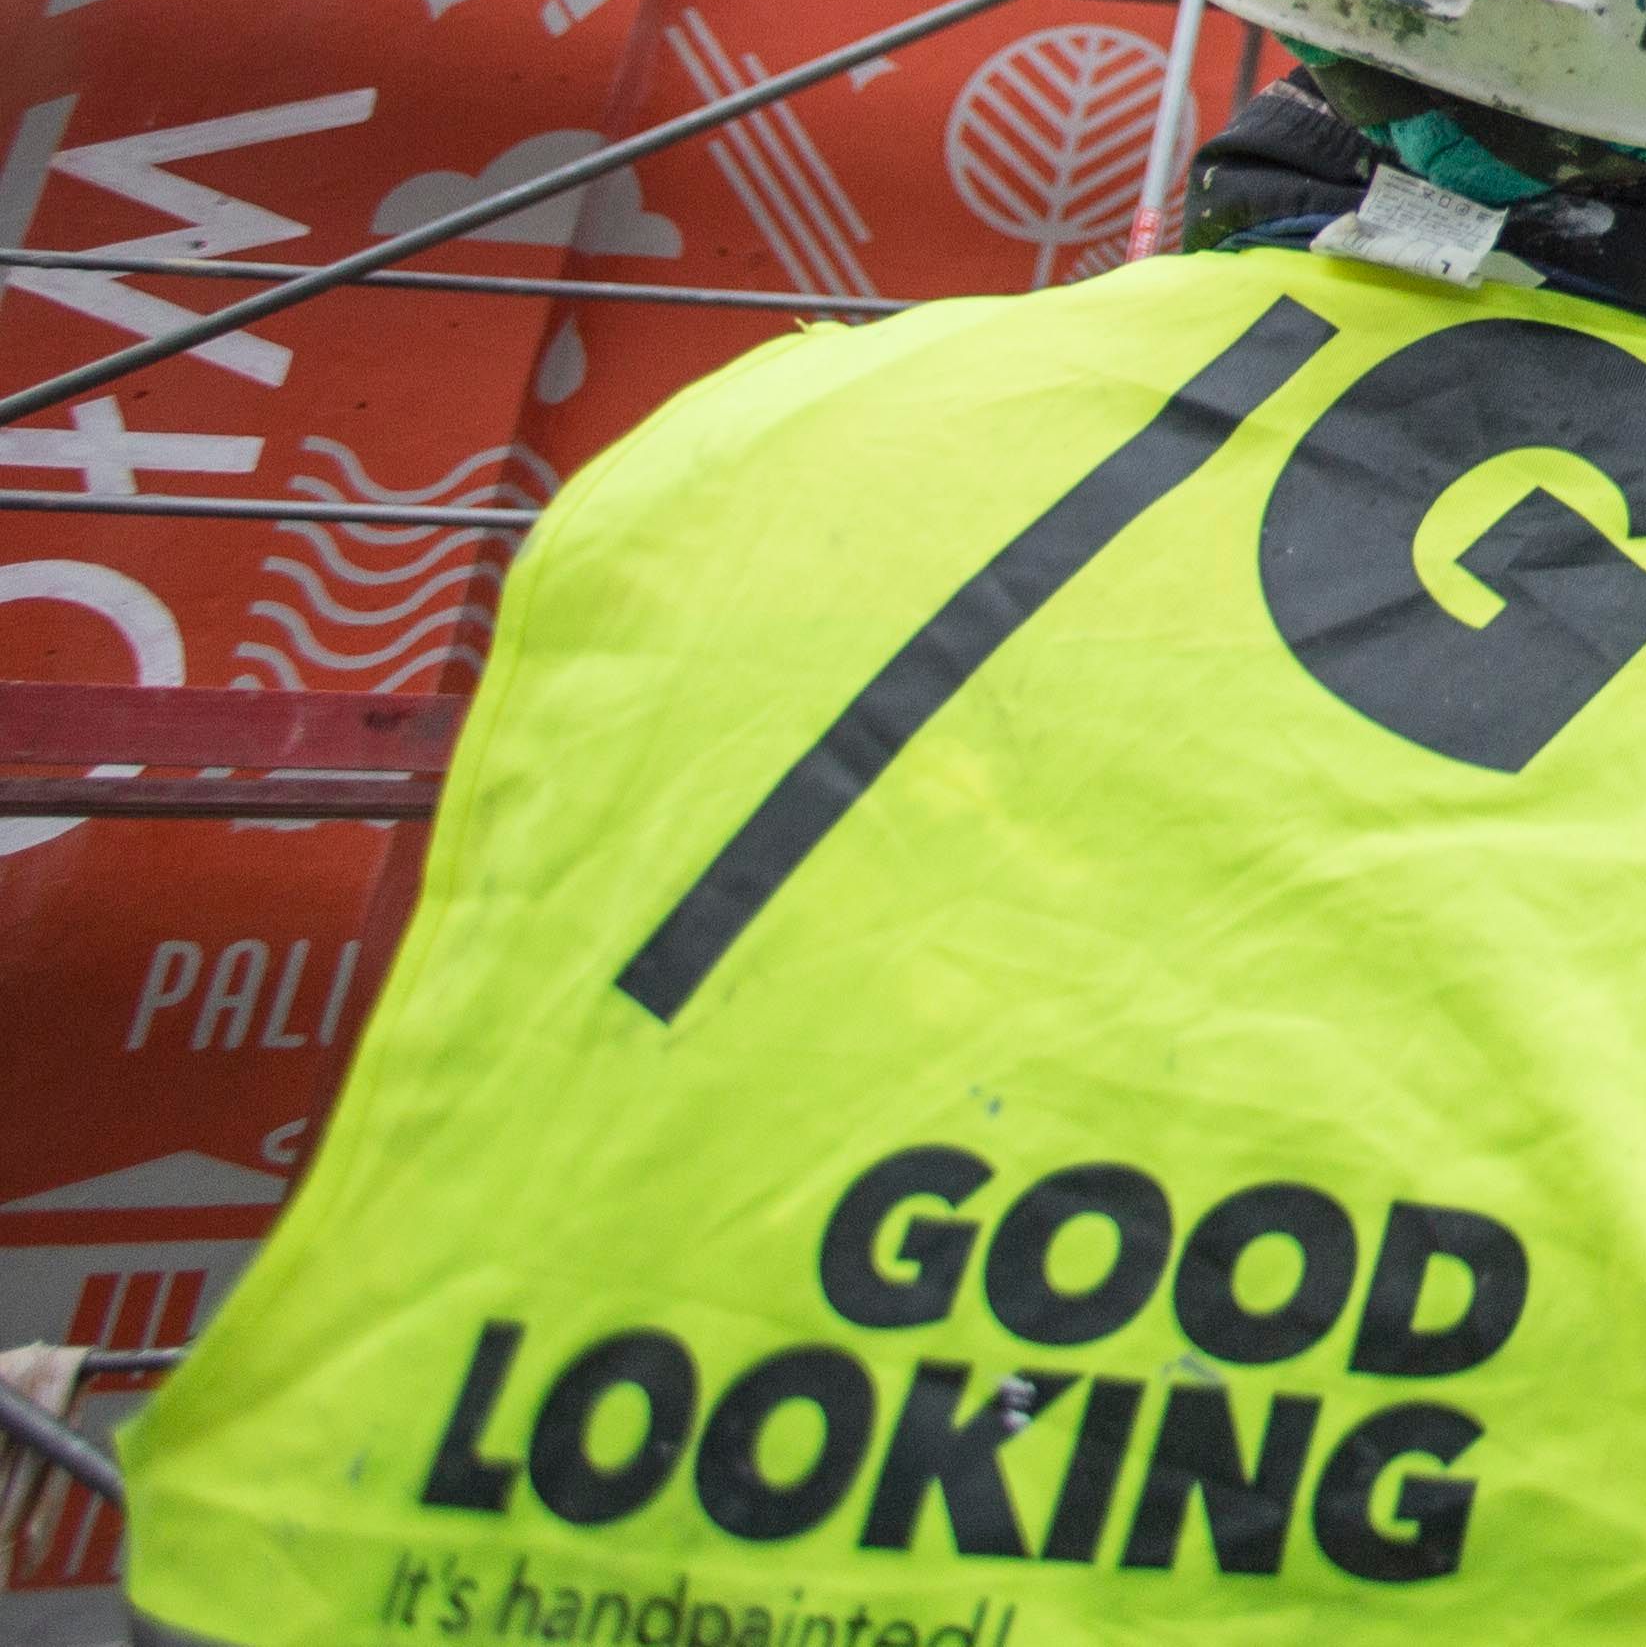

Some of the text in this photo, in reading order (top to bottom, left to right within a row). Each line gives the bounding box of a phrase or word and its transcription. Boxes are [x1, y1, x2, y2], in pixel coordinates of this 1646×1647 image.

[817, 1143, 1530, 1379] GOOD
[421, 1320, 1488, 1584] LOOKING
[383, 1553, 479, 1634] It's
